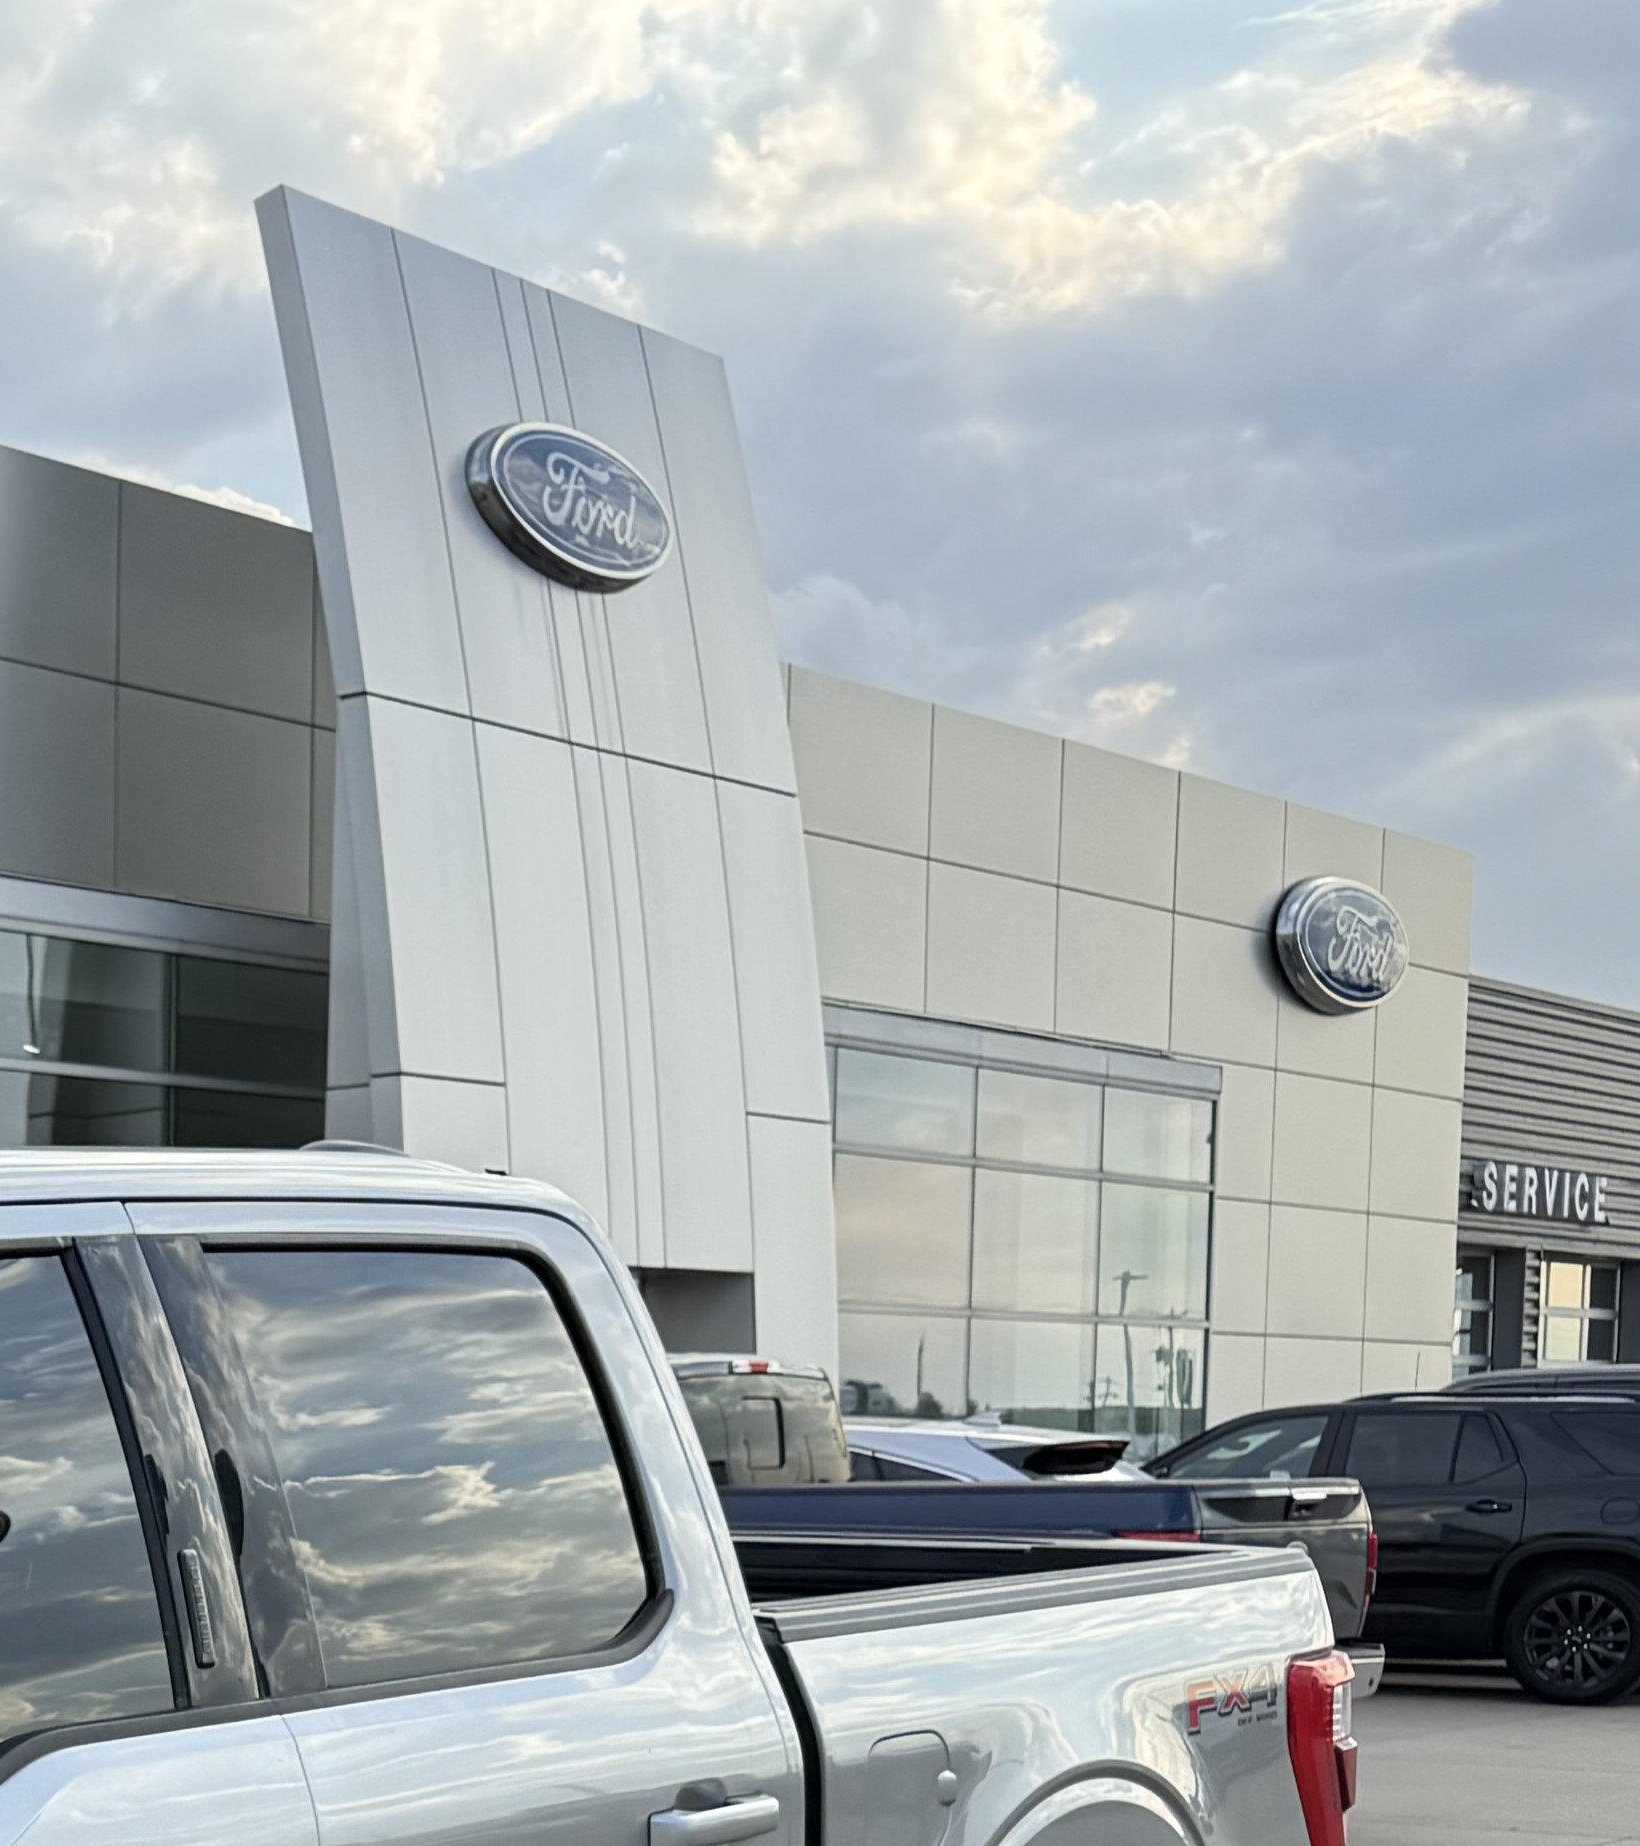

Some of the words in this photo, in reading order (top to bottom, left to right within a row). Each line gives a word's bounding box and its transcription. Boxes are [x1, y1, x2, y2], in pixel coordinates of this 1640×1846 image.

[542, 451, 641, 549] Ford
[1327, 904, 1392, 983] Ford
[1482, 1161, 1608, 1223] SERVICE
[1184, 1664, 1278, 1735] FX4
